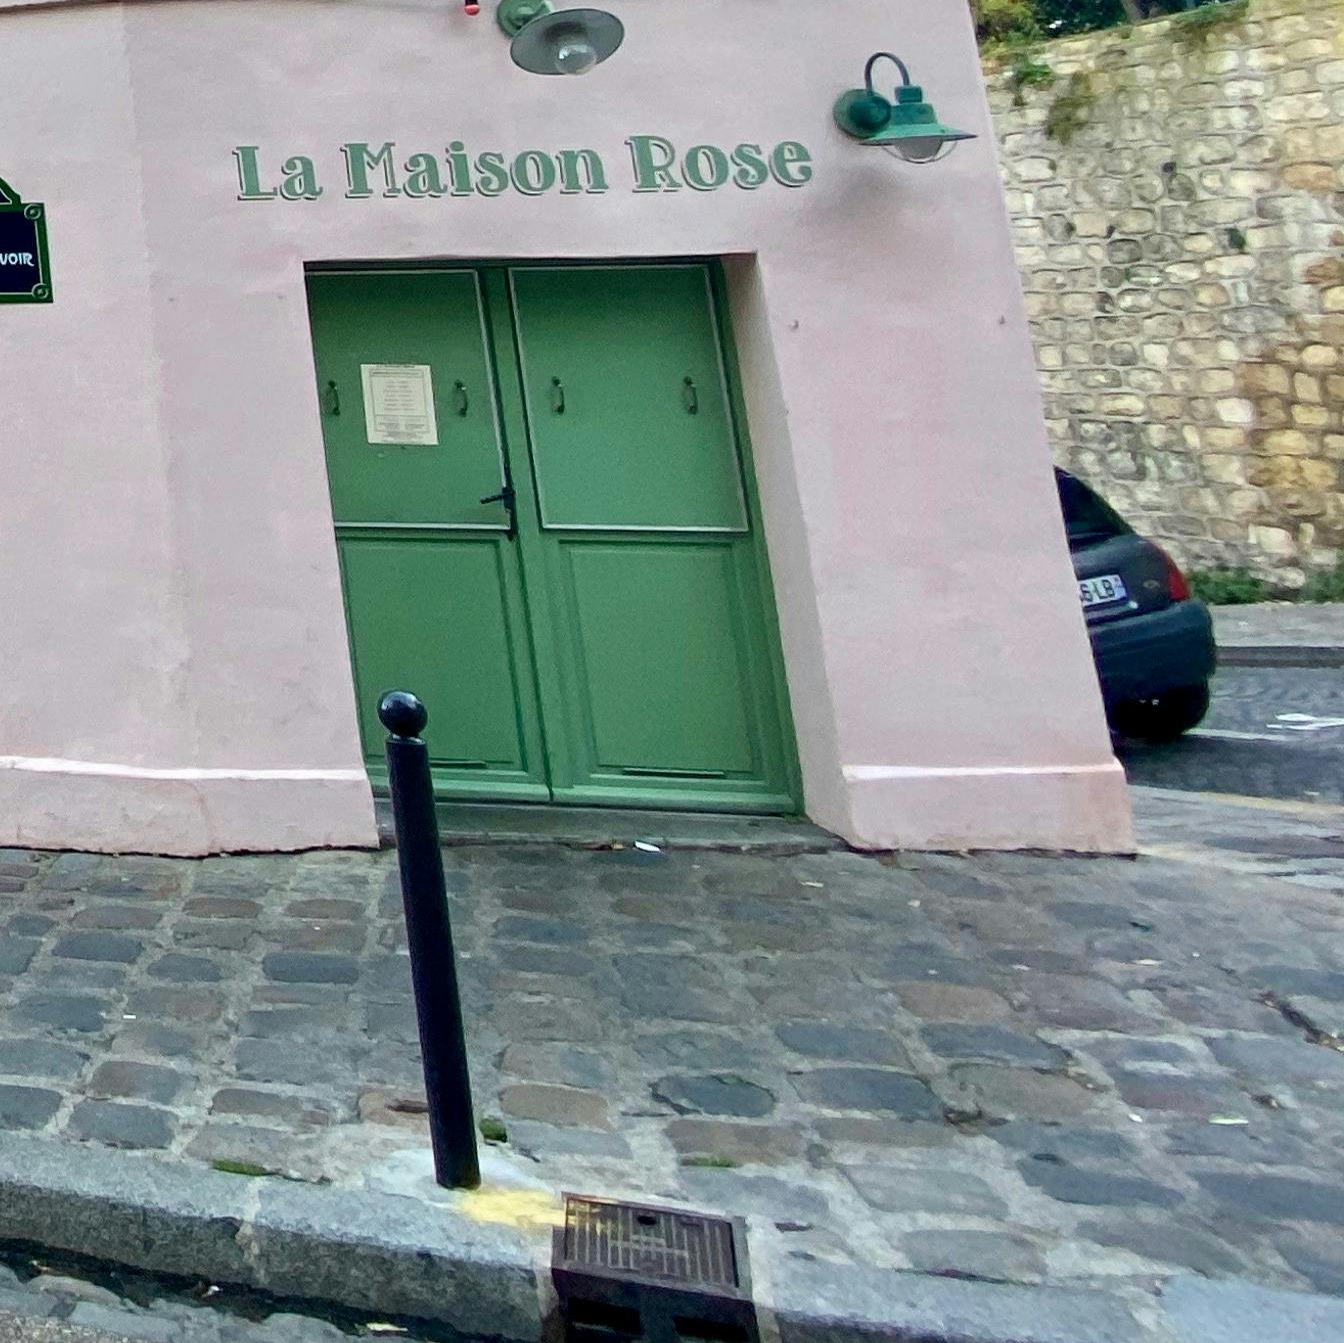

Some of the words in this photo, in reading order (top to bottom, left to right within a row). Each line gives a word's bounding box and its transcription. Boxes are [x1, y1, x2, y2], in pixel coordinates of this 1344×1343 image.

[232, 146, 323, 201] La
[340, 140, 609, 199] Maison
[624, 135, 812, 193] Rose
